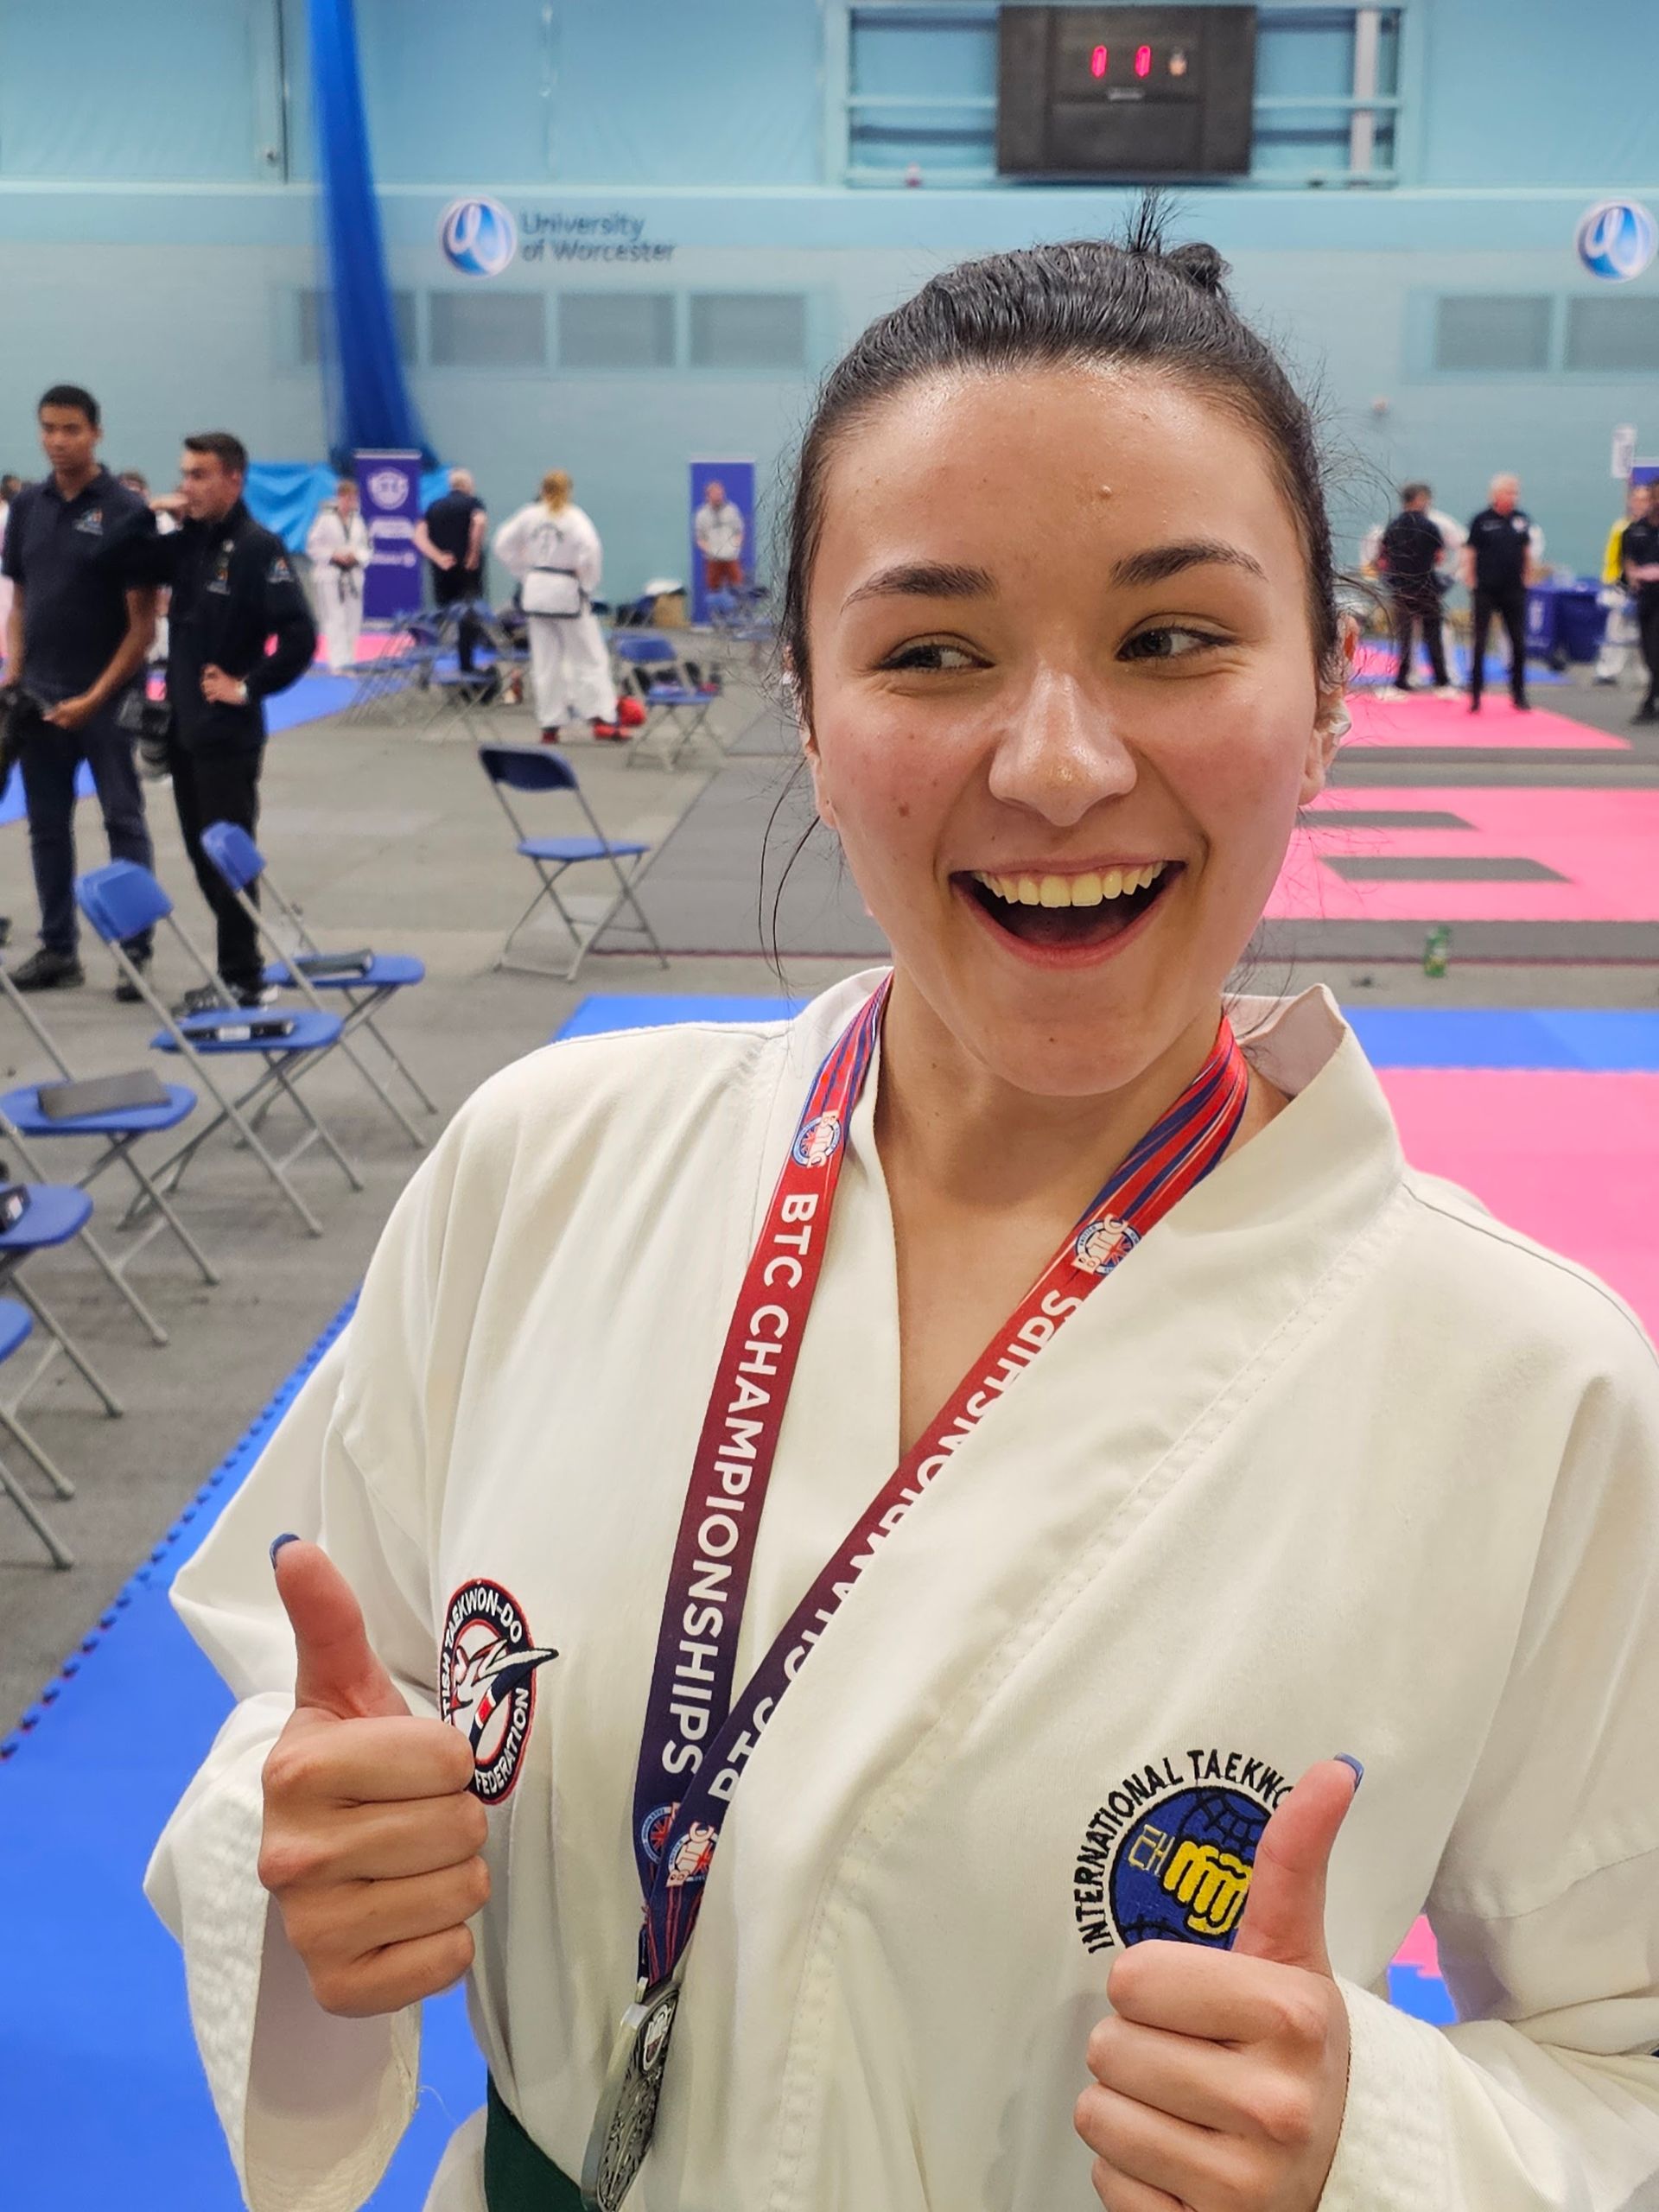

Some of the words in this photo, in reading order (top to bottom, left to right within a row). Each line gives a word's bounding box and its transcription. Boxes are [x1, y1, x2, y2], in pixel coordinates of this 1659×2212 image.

[521, 213, 645, 240] University
[522, 239, 544, 261] of
[554, 241, 675, 261] Worcester
[807, 1109, 840, 1168] BTC
[764, 1193, 819, 1289] BTC
[1071, 1213, 1129, 1274] BTC
[662, 1305, 790, 1774] CHAMPIONSHIPS
[446, 1587, 522, 1649] TAEKWON-DO
[475, 1687, 529, 1795] FEDERATION
[665, 1821, 715, 1887] BTC
[1074, 1757, 1184, 1955] INTERNATIONAL
